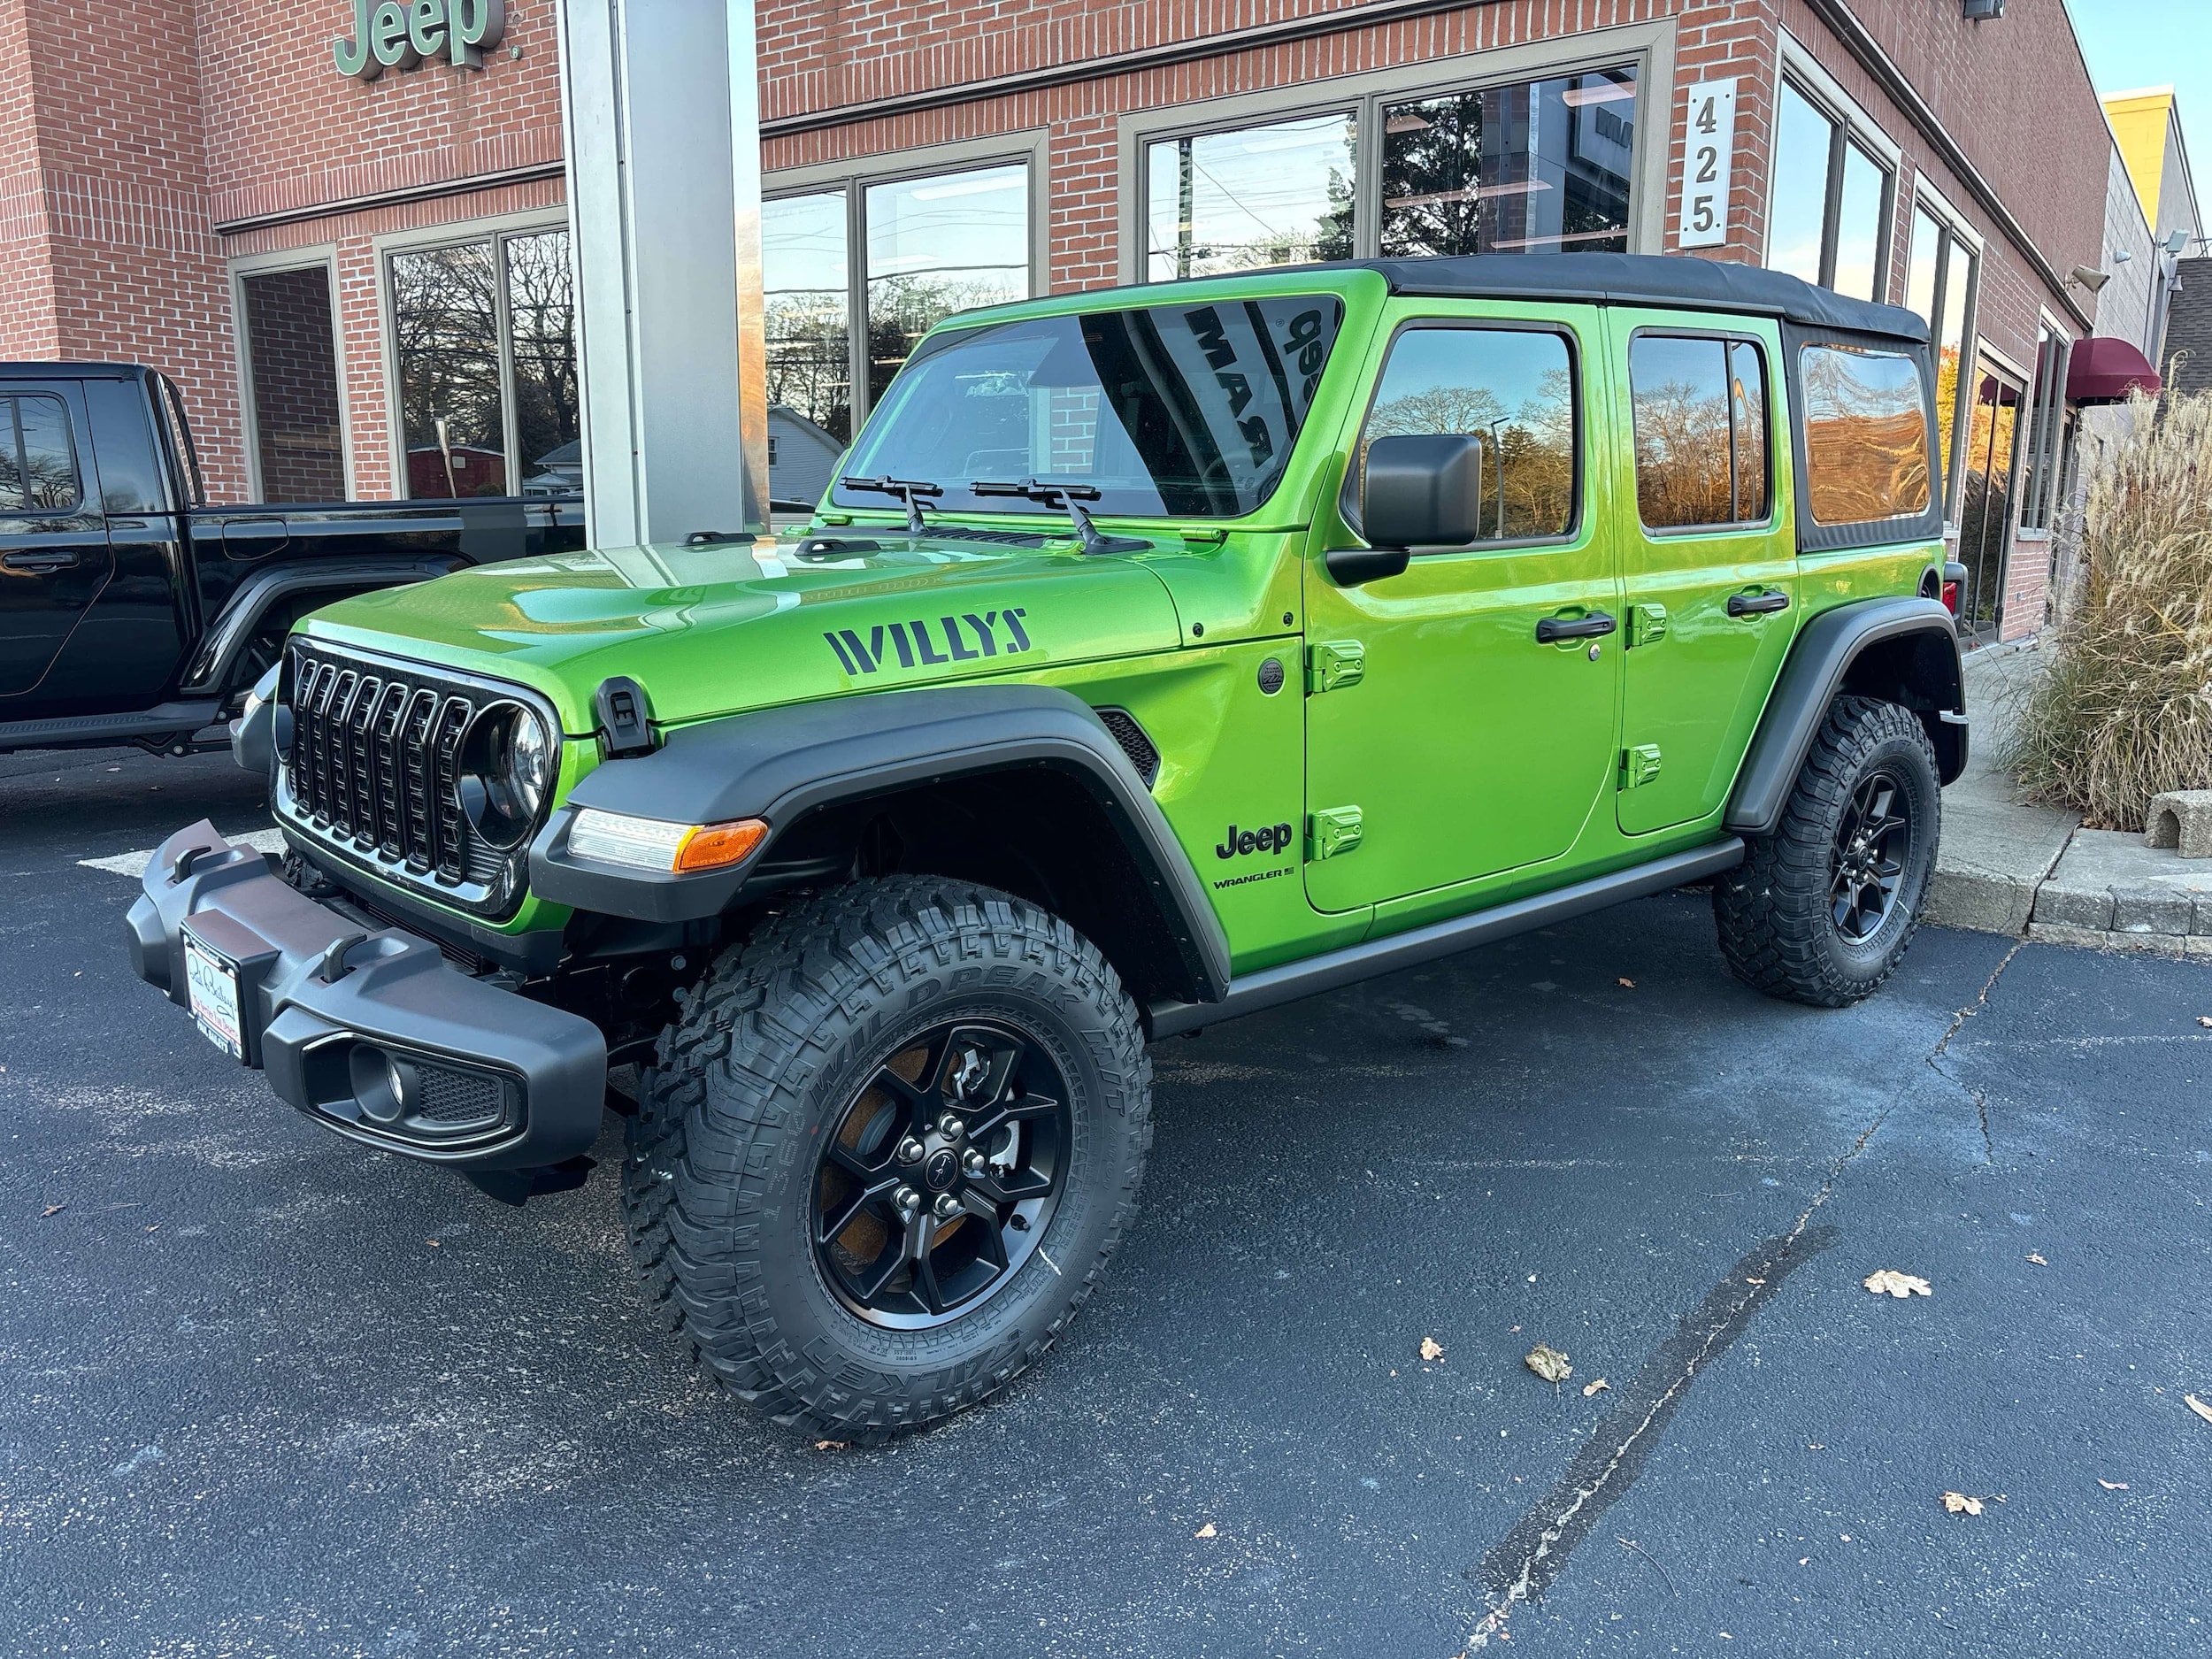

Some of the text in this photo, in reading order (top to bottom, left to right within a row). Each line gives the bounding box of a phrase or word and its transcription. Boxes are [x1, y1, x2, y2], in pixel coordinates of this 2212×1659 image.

[334, 0, 488, 76] Jeep
[1693, 96, 1717, 232] 425
[823, 609, 1031, 676] WILLYS
[1216, 823, 1292, 859] Jeep
[1213, 869, 1283, 890] WRANGLER
